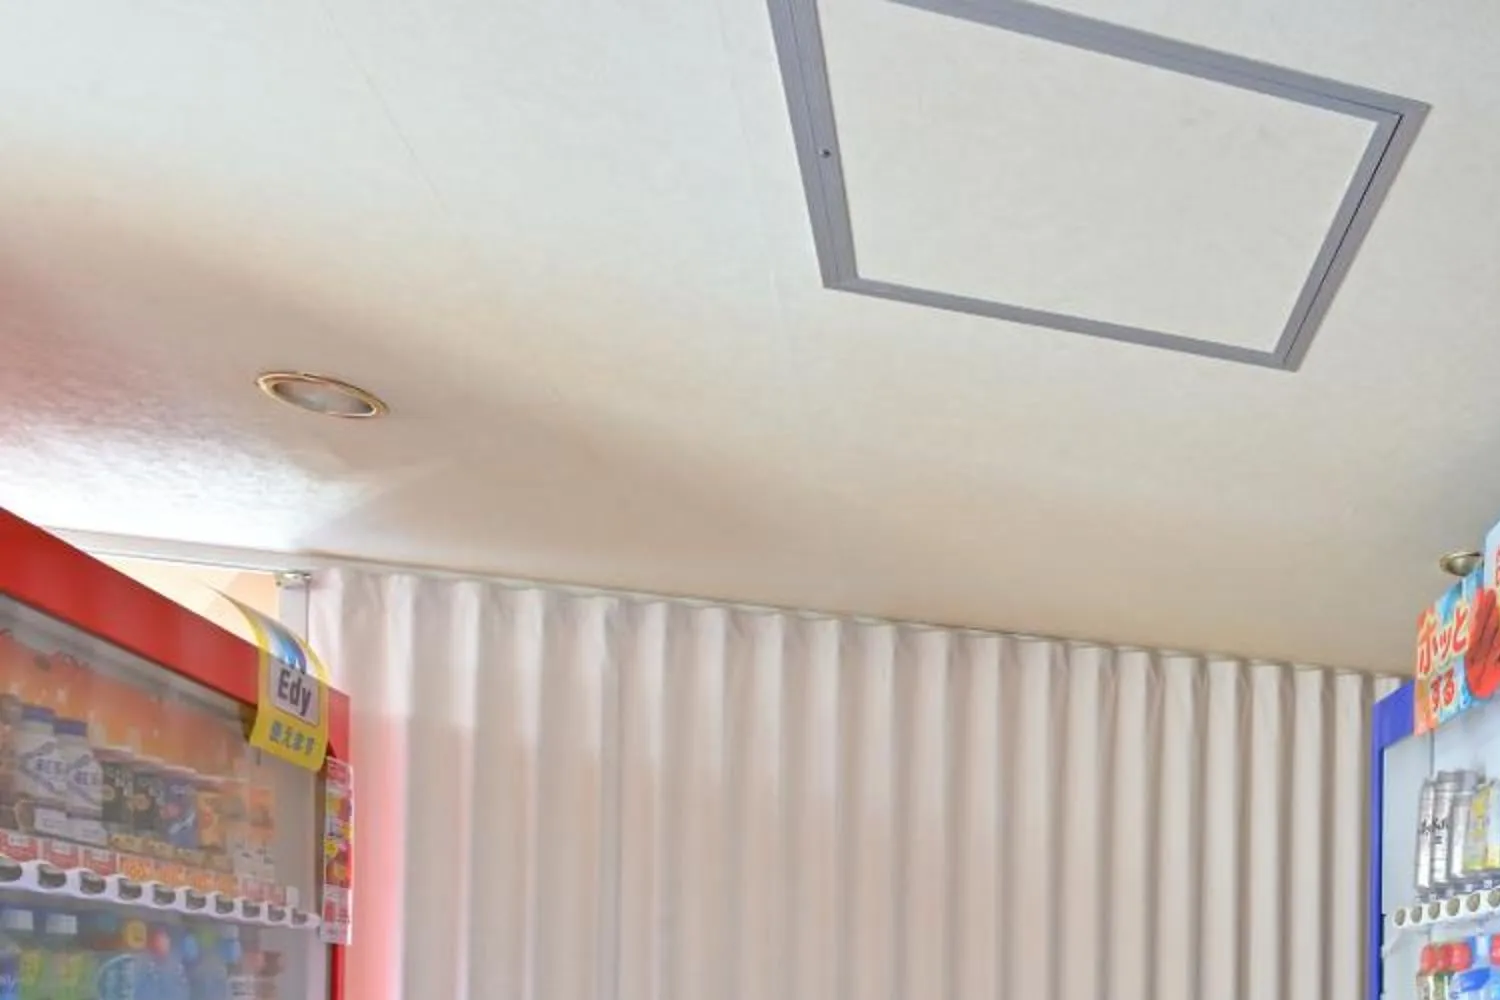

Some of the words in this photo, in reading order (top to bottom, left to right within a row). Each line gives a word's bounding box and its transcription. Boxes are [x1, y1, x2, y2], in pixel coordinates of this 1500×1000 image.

[1418, 602, 1468, 674] ホッと
[278, 668, 311, 717] Edy
[1430, 666, 1456, 712] する
